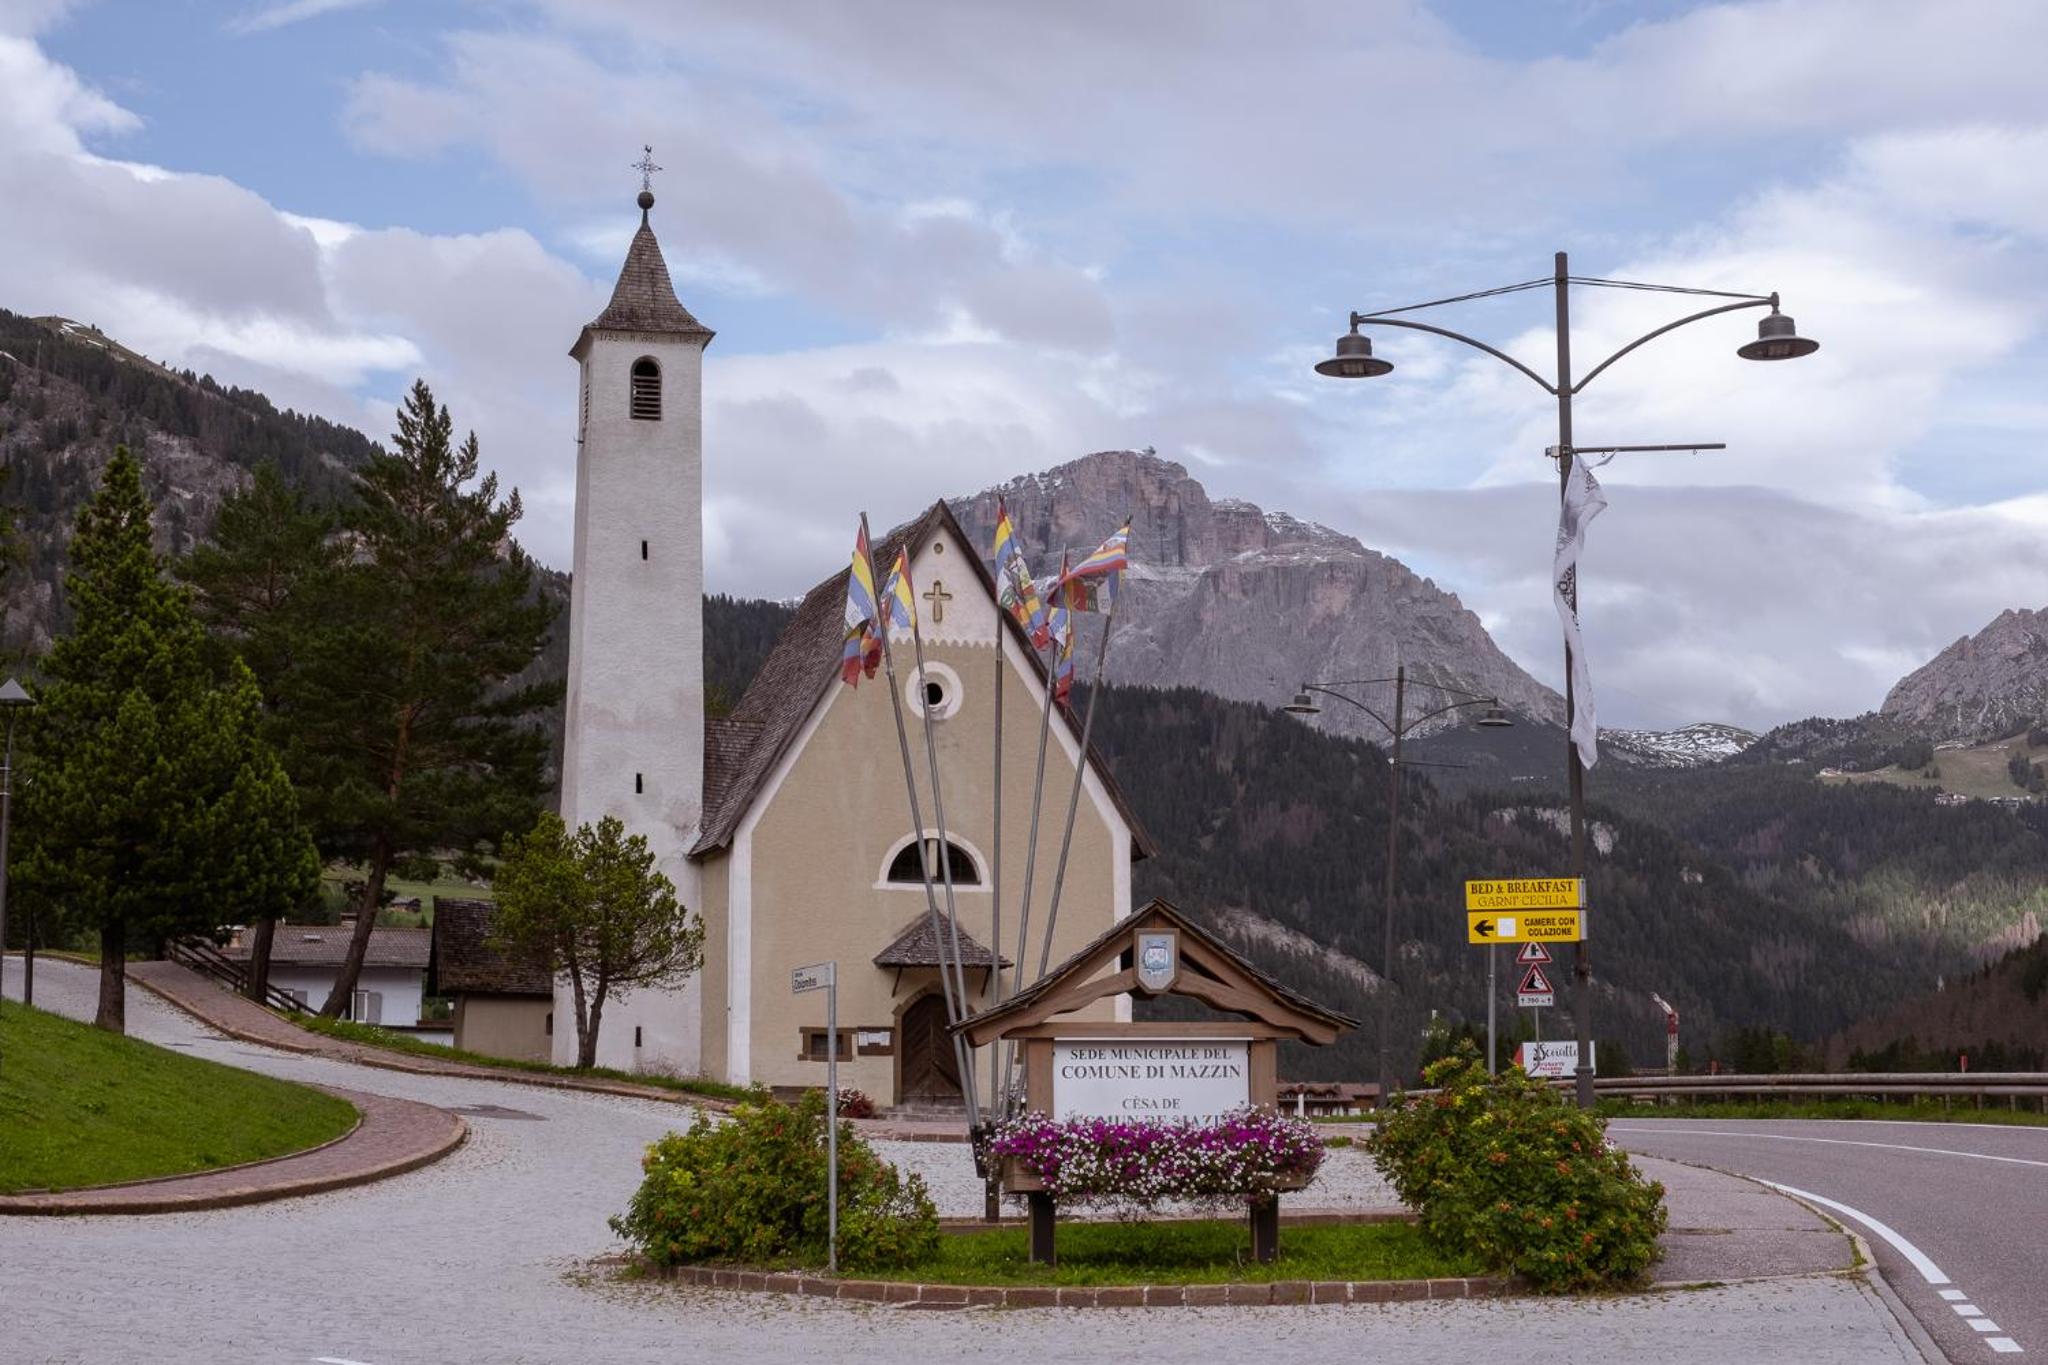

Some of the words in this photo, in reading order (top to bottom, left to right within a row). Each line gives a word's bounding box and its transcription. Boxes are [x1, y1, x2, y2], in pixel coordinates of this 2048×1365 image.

[1471, 883, 1493, 894] BED
[1496, 883, 1504, 893] &
[1508, 881, 1573, 893] BREAKFAST
[1521, 894, 1568, 905] CECILIA
[1524, 918, 1556, 926] CAMERE
[1558, 917, 1575, 925] CON
[1528, 927, 1572, 936] COLAZIONE
[1071, 1048, 1106, 1060] SEDE
[1111, 1048, 1199, 1060] MUNICIPALE
[1204, 1047, 1232, 1059] DEL
[1061, 1065, 1140, 1079] COMUNE
[1147, 1065, 1164, 1079] DI
[1170, 1064, 1241, 1078] MAZZIN
[1162, 1098, 1180, 1109] DE
